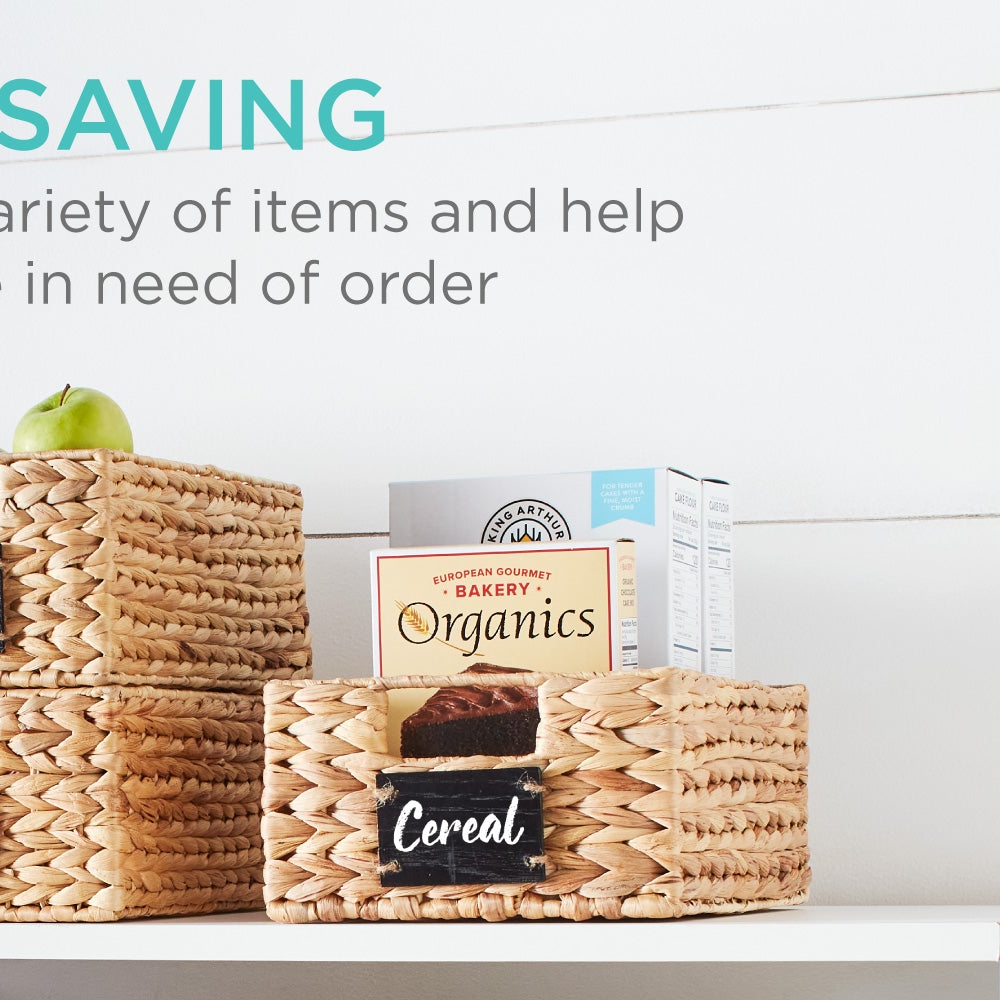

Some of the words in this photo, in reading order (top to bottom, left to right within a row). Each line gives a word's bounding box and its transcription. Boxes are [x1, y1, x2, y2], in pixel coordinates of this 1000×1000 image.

[486, 510, 513, 544] KING
[516, 505, 565, 540] ARTHUR
[432, 567, 493, 586] EUROPEAN
[496, 567, 553, 581] GOURMET
[455, 582, 531, 598] BAKERY
[397, 597, 595, 658] Organics
[393, 795, 525, 853] Cereal
